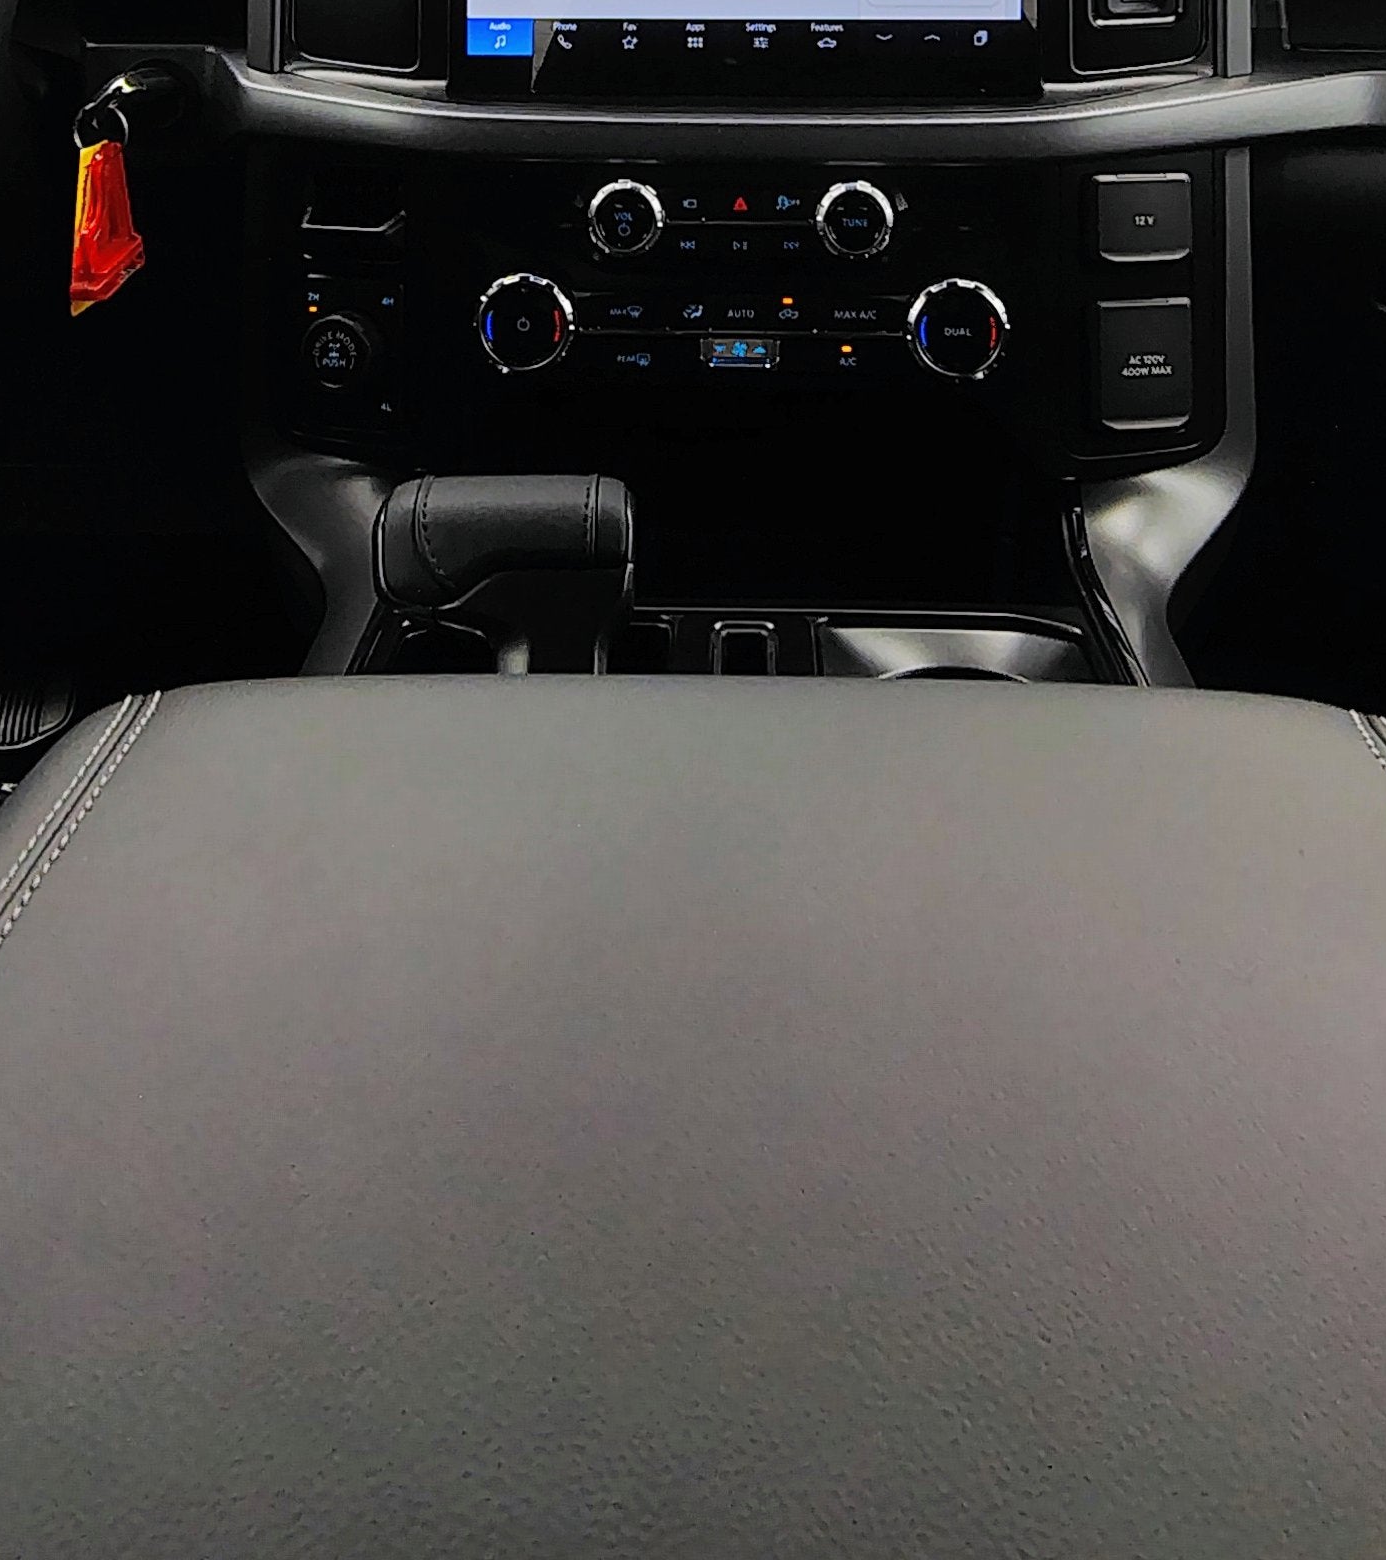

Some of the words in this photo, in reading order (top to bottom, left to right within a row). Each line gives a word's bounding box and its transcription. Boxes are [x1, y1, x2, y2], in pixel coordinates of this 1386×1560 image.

[489, 22, 511, 31] Audio
[553, 22, 577, 32] Phone
[685, 22, 706, 33] Apps
[745, 22, 777, 33] Settings
[810, 23, 844, 32] Features
[614, 211, 633, 221] VOL
[842, 217, 868, 227] TUNE
[727, 308, 755, 319] AUTO
[834, 309, 857, 320] MAX
[859, 309, 877, 320] A/C
[943, 327, 974, 337] DUAL
[313, 330, 333, 357] DRIVE
[335, 329, 357, 357] MODE
[322, 357, 346, 368] PUSH
[839, 356, 857, 367] A/C
[1128, 355, 1142, 365] AC
[1121, 366, 1150, 377] 400W
[1150, 365, 1173, 375] MAX
